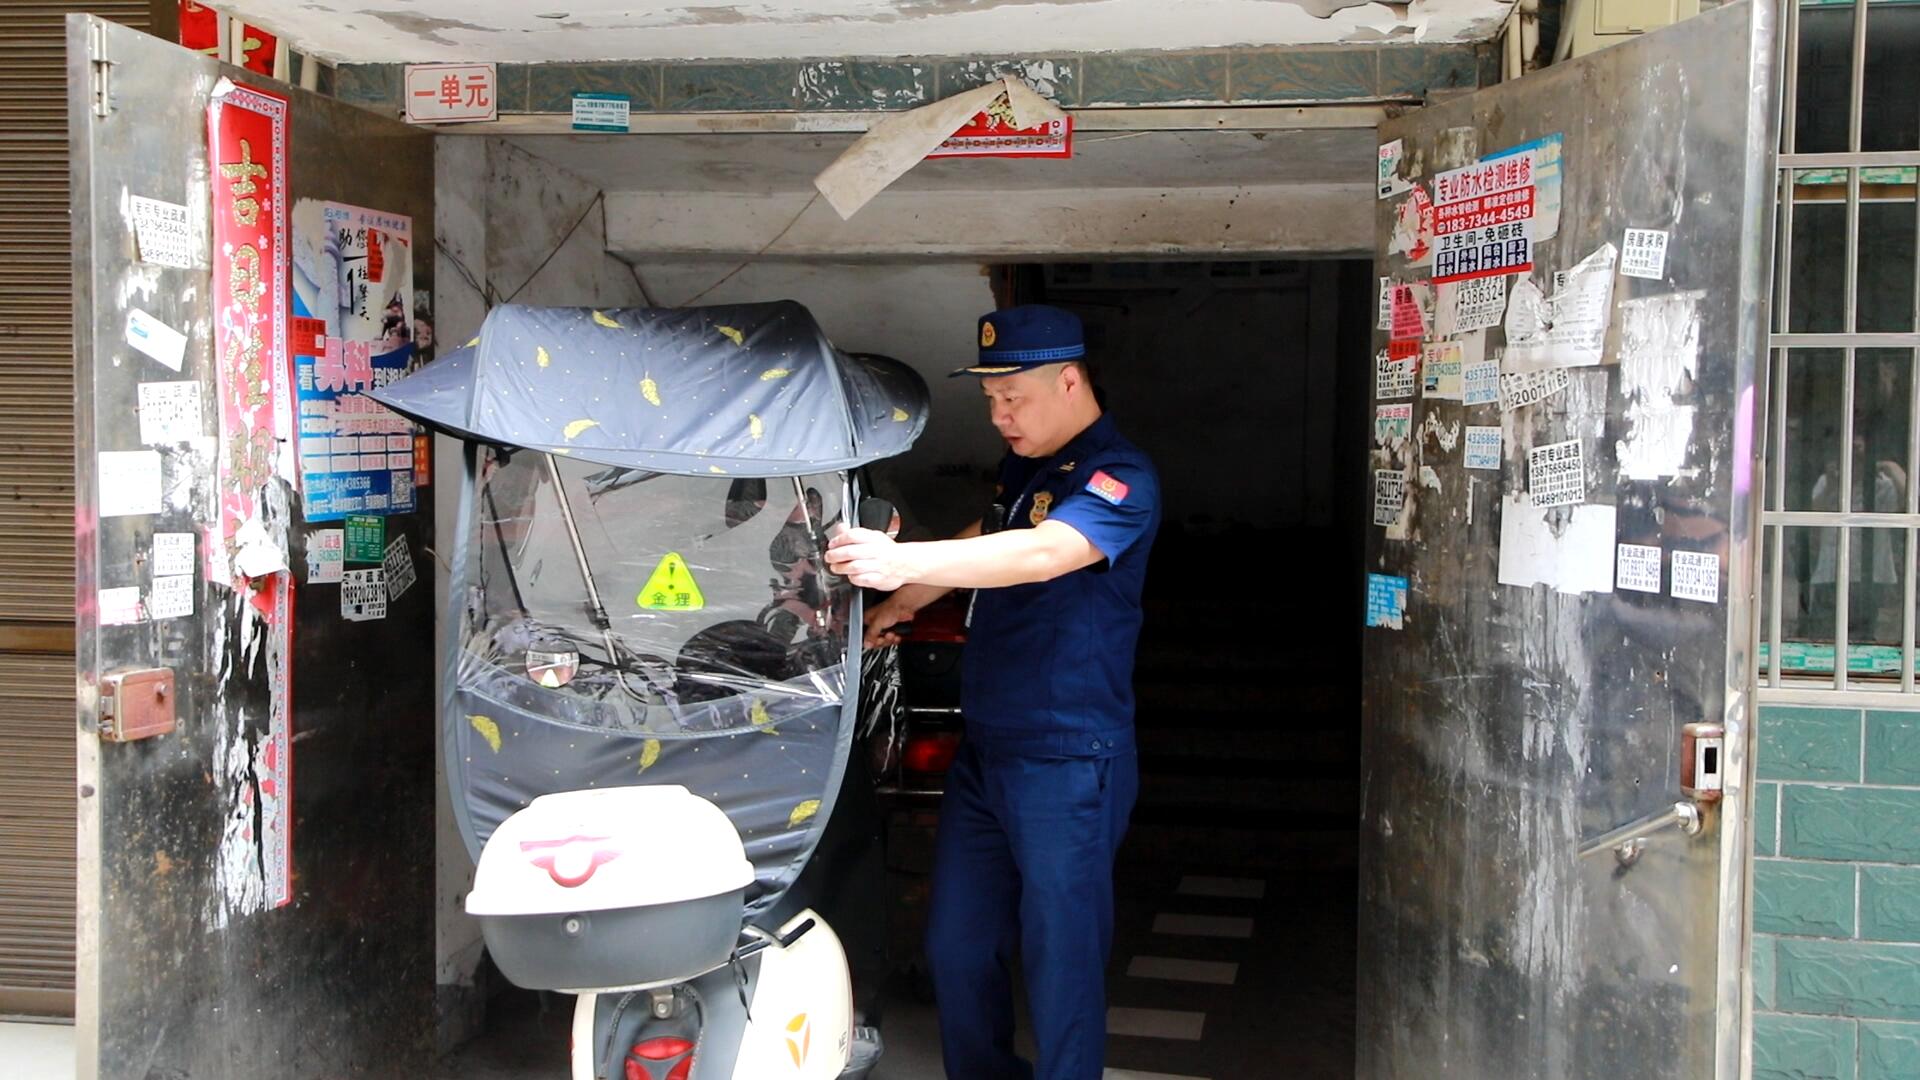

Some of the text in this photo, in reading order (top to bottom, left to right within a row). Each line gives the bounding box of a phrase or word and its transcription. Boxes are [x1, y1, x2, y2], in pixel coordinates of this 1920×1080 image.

[414, 74, 489, 109] 一单元
[1439, 155, 1531, 202] 专业防水检测维修
[1446, 203, 1531, 233] 183-7344-4549
[1441, 221, 1524, 251] 卫生间-免砸砖
[1459, 284, 1504, 306] 4386324
[1464, 366, 1498, 381] 4357322
[1531, 458, 1582, 479] 13875658450
